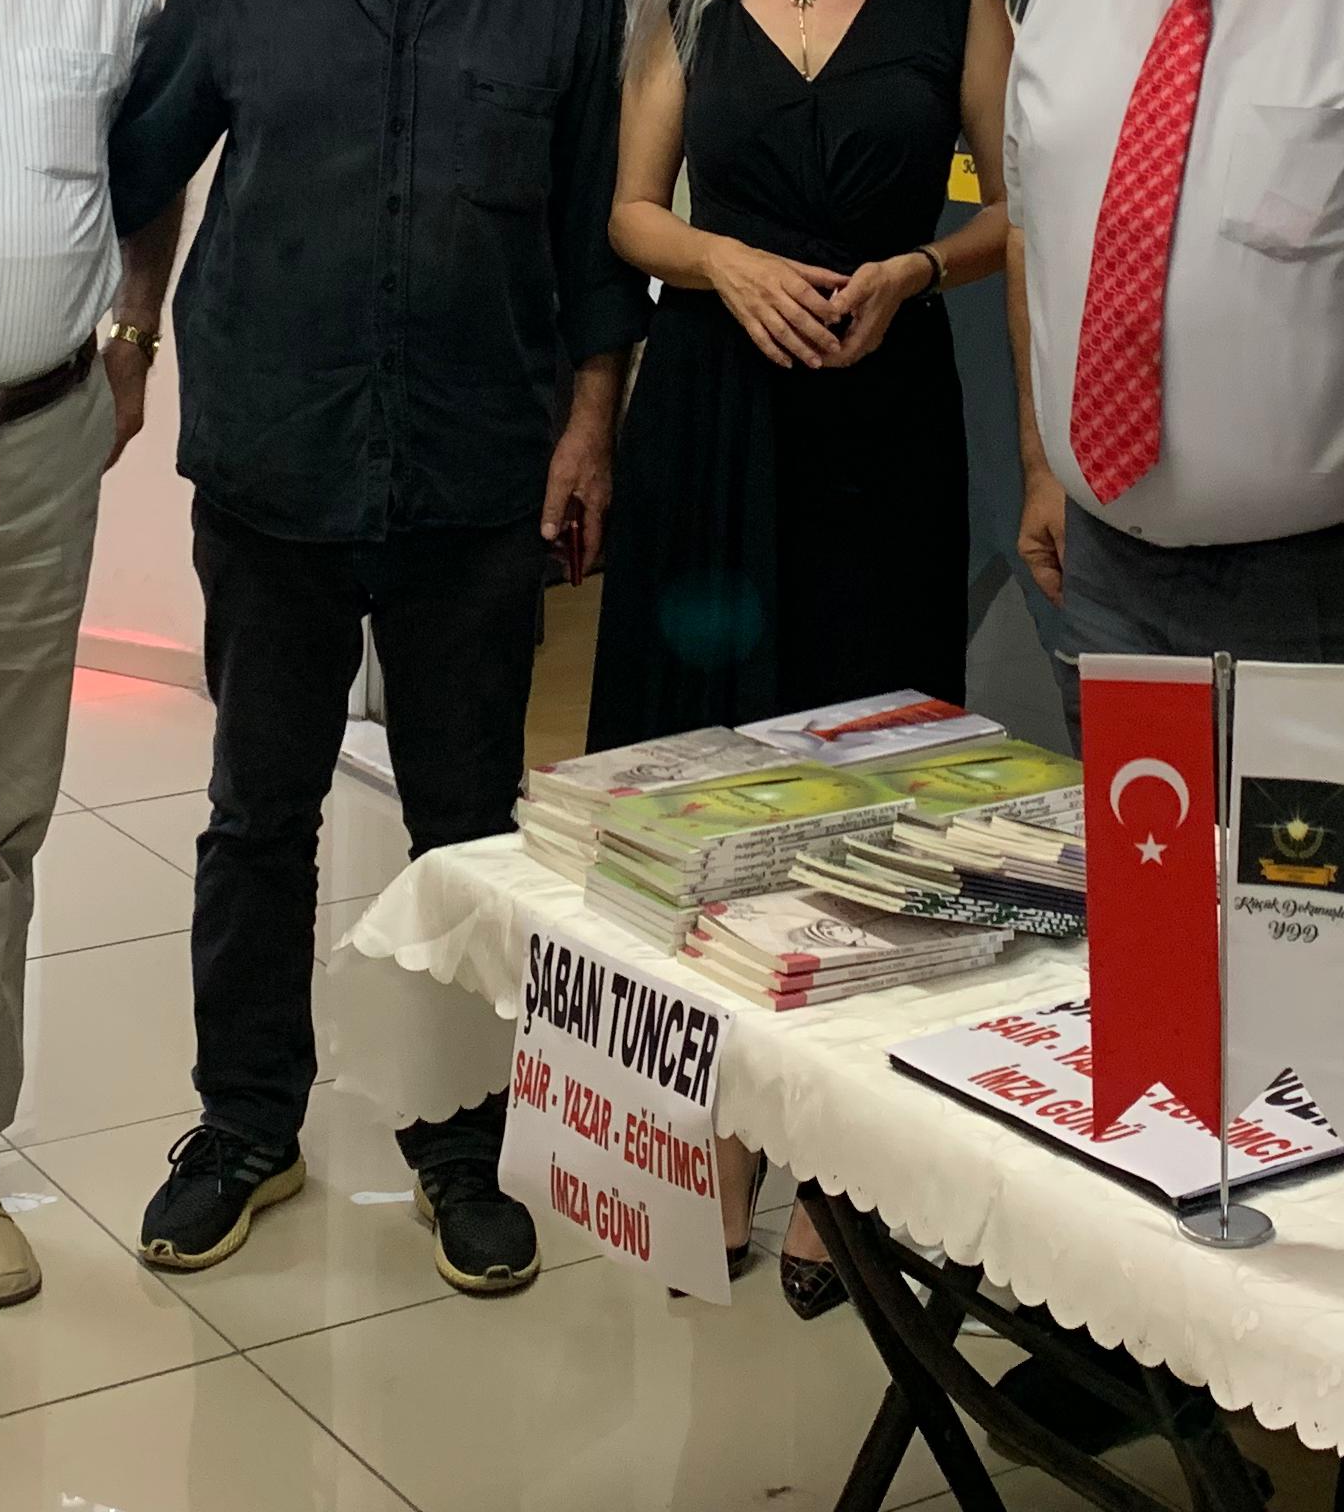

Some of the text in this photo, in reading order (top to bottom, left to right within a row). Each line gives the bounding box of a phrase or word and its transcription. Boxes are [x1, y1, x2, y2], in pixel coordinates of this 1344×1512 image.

[523, 932, 720, 1107] ŞABAN TUNCER
[513, 1048, 552, 1113] ŞAİR
[562, 1074, 613, 1150] YAZAR
[623, 1106, 716, 1200] EĞİTİMCİ
[550, 1152, 651, 1263] İMZA GÜNÜ
